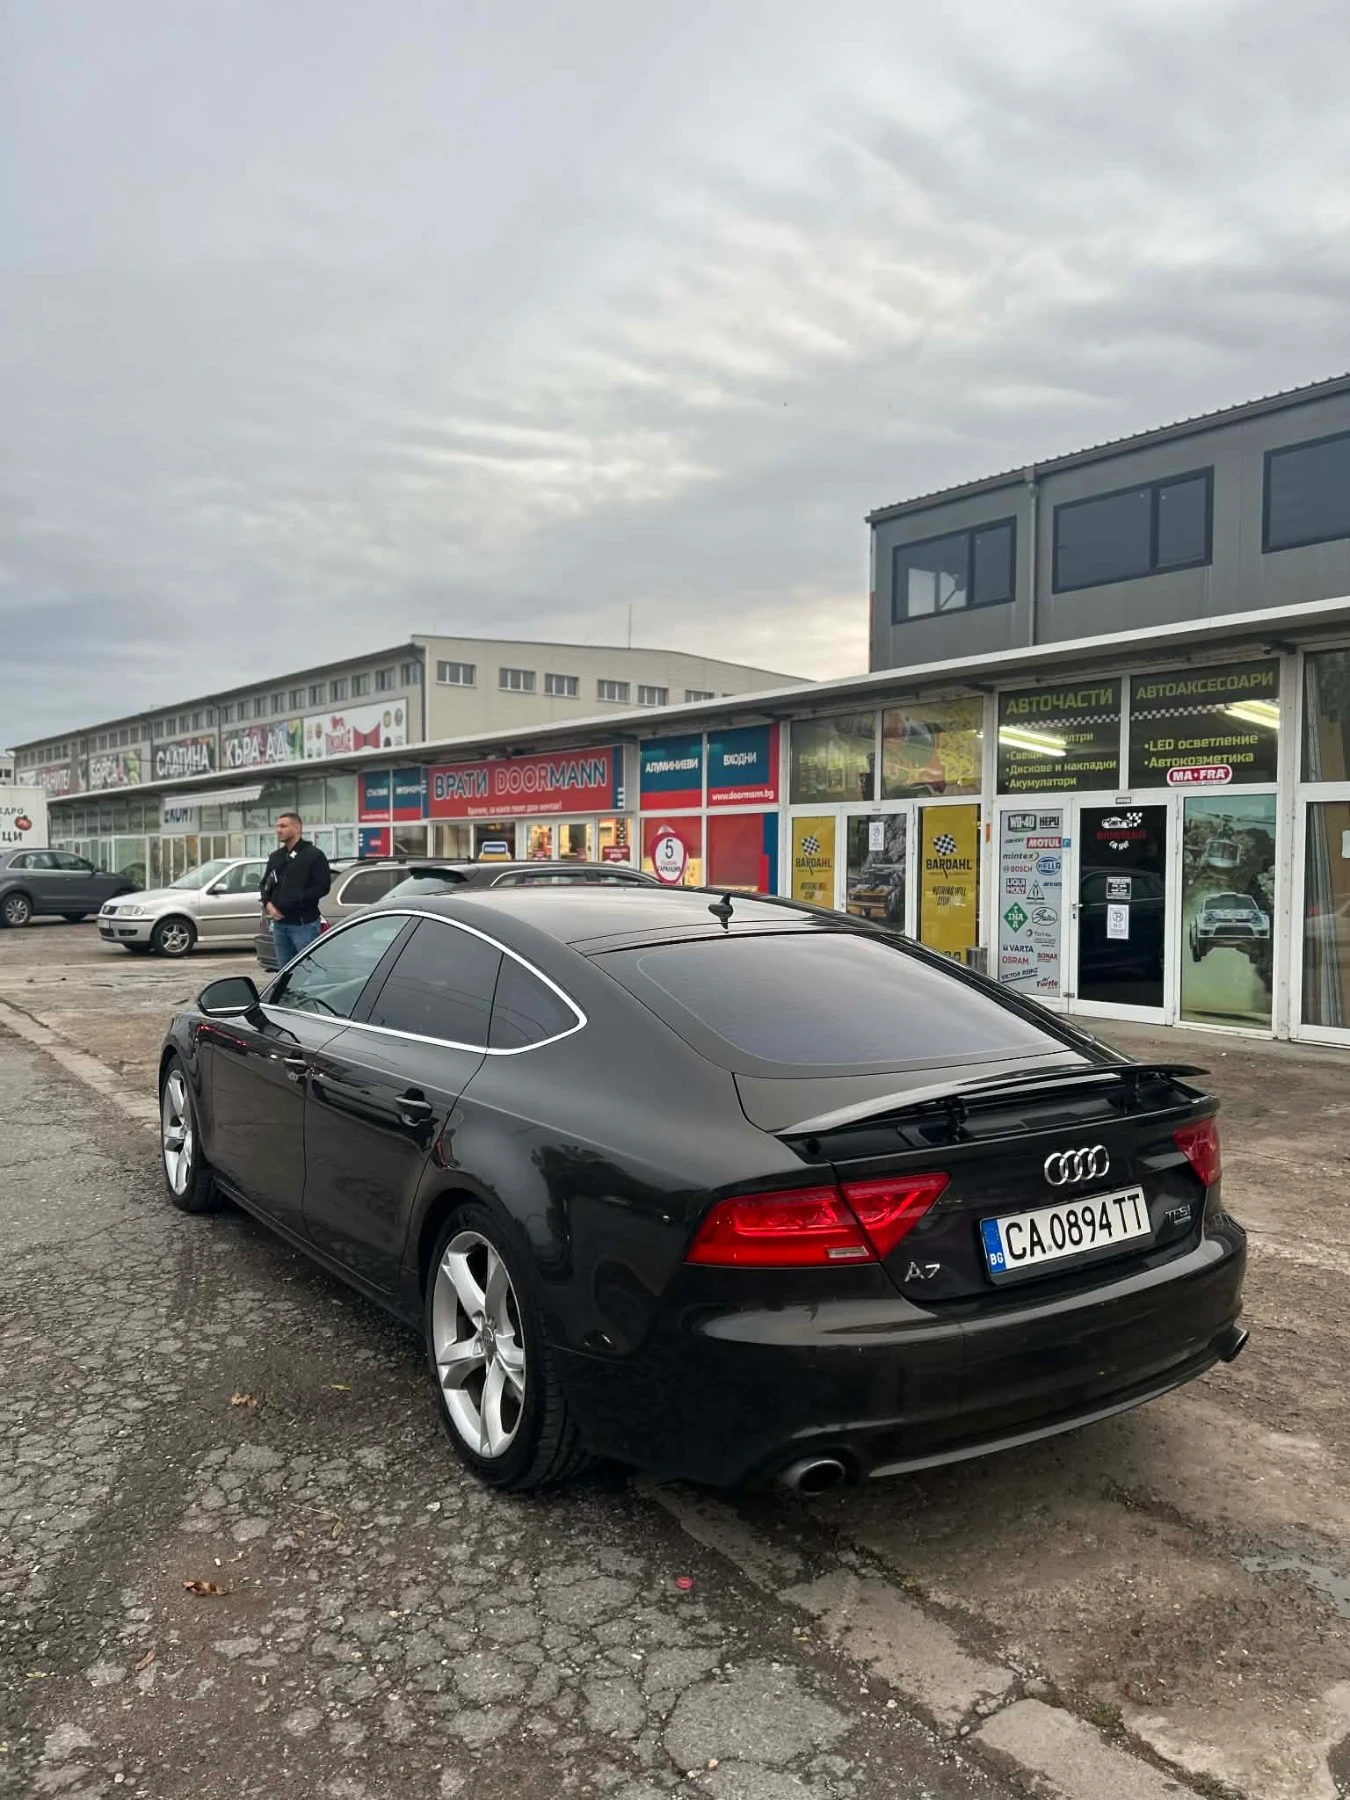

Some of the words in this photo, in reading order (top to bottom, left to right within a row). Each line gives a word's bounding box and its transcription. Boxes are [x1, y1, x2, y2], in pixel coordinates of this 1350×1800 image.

[1136, 672, 1273, 700] АВТОАКСЕСОАРИ
[1006, 688, 1113, 715] АВТОЧАСТИ
[1149, 739, 1174, 751] LED
[1178, 734, 1258, 750] осветление
[156, 744, 210, 776] СЛАТИНА
[645, 758, 699, 773] АЛУМИНИЕВИ
[723, 752, 757, 766] ВХОДНИ
[1149, 752, 1254, 768] Автокозметика
[1009, 765, 1052, 776] Дискове
[1055, 763, 1061, 772] и
[1063, 759, 1116, 772] накладки
[434, 768, 488, 800] ВРАТИ
[495, 758, 607, 795] DOORMANN
[1008, 776, 1077, 788] Акумулатори
[712, 789, 774, 801] www.doormann.bg
[1009, 815, 1035, 828] WD-40
[1040, 815, 1060, 826] HEPU
[665, 838, 674, 859] 5
[1028, 838, 1060, 848] MOTUL
[795, 857, 832, 868] BARDAHL
[1002, 851, 1034, 860] mintex
[926, 858, 972, 870] BARDAHL
[1006, 886, 1026, 894] MOLY
[1002, 956, 1029, 965] OSRAM
[1164, 1204, 1191, 1221] TFSI
[990, 1252, 1004, 1265] BG
[904, 1261, 940, 1282] A7
